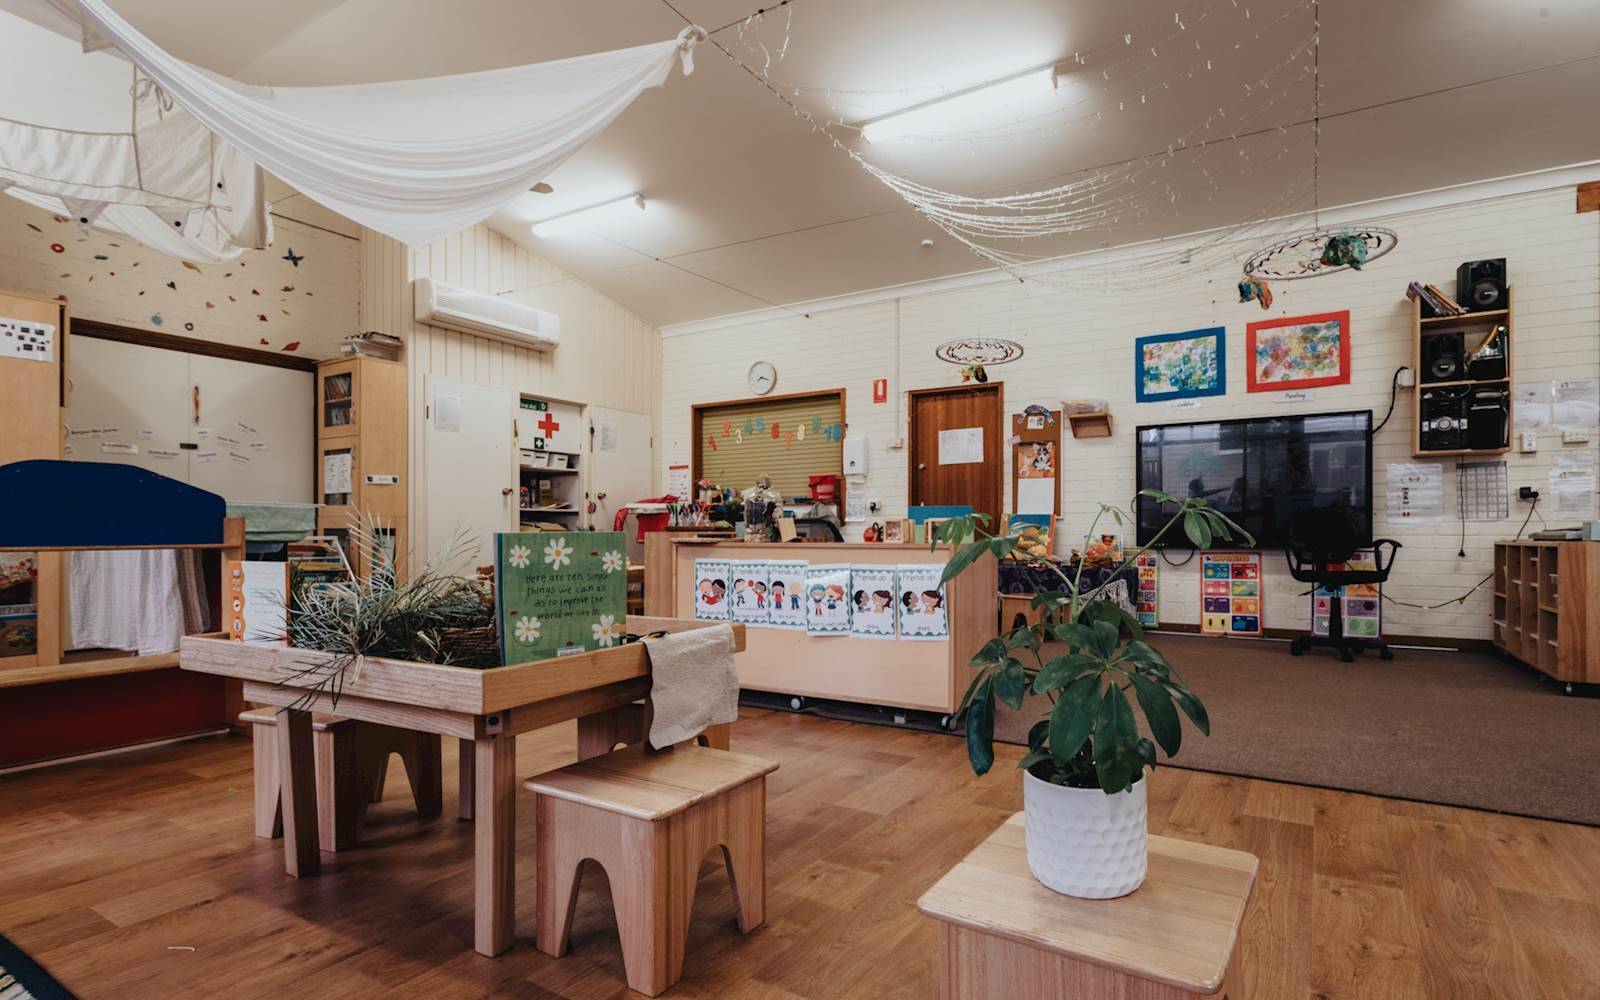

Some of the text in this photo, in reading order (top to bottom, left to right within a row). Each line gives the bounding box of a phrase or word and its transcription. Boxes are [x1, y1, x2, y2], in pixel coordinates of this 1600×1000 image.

[722, 420, 731, 438] 2
[735, 428, 742, 444] 3
[743, 416, 753, 435] 4
[755, 415, 765, 432] 5
[771, 422, 780, 440] 6
[784, 431, 793, 449] 7
[797, 423, 805, 441] 8
[526, 574, 546, 584] Here
[567, 573, 583, 581] ten
[527, 586, 556, 598] things
[576, 585, 594, 593] can
[596, 583, 606, 592] all
[534, 595, 603, 608] do to improve the
[537, 610, 562, 619] world
